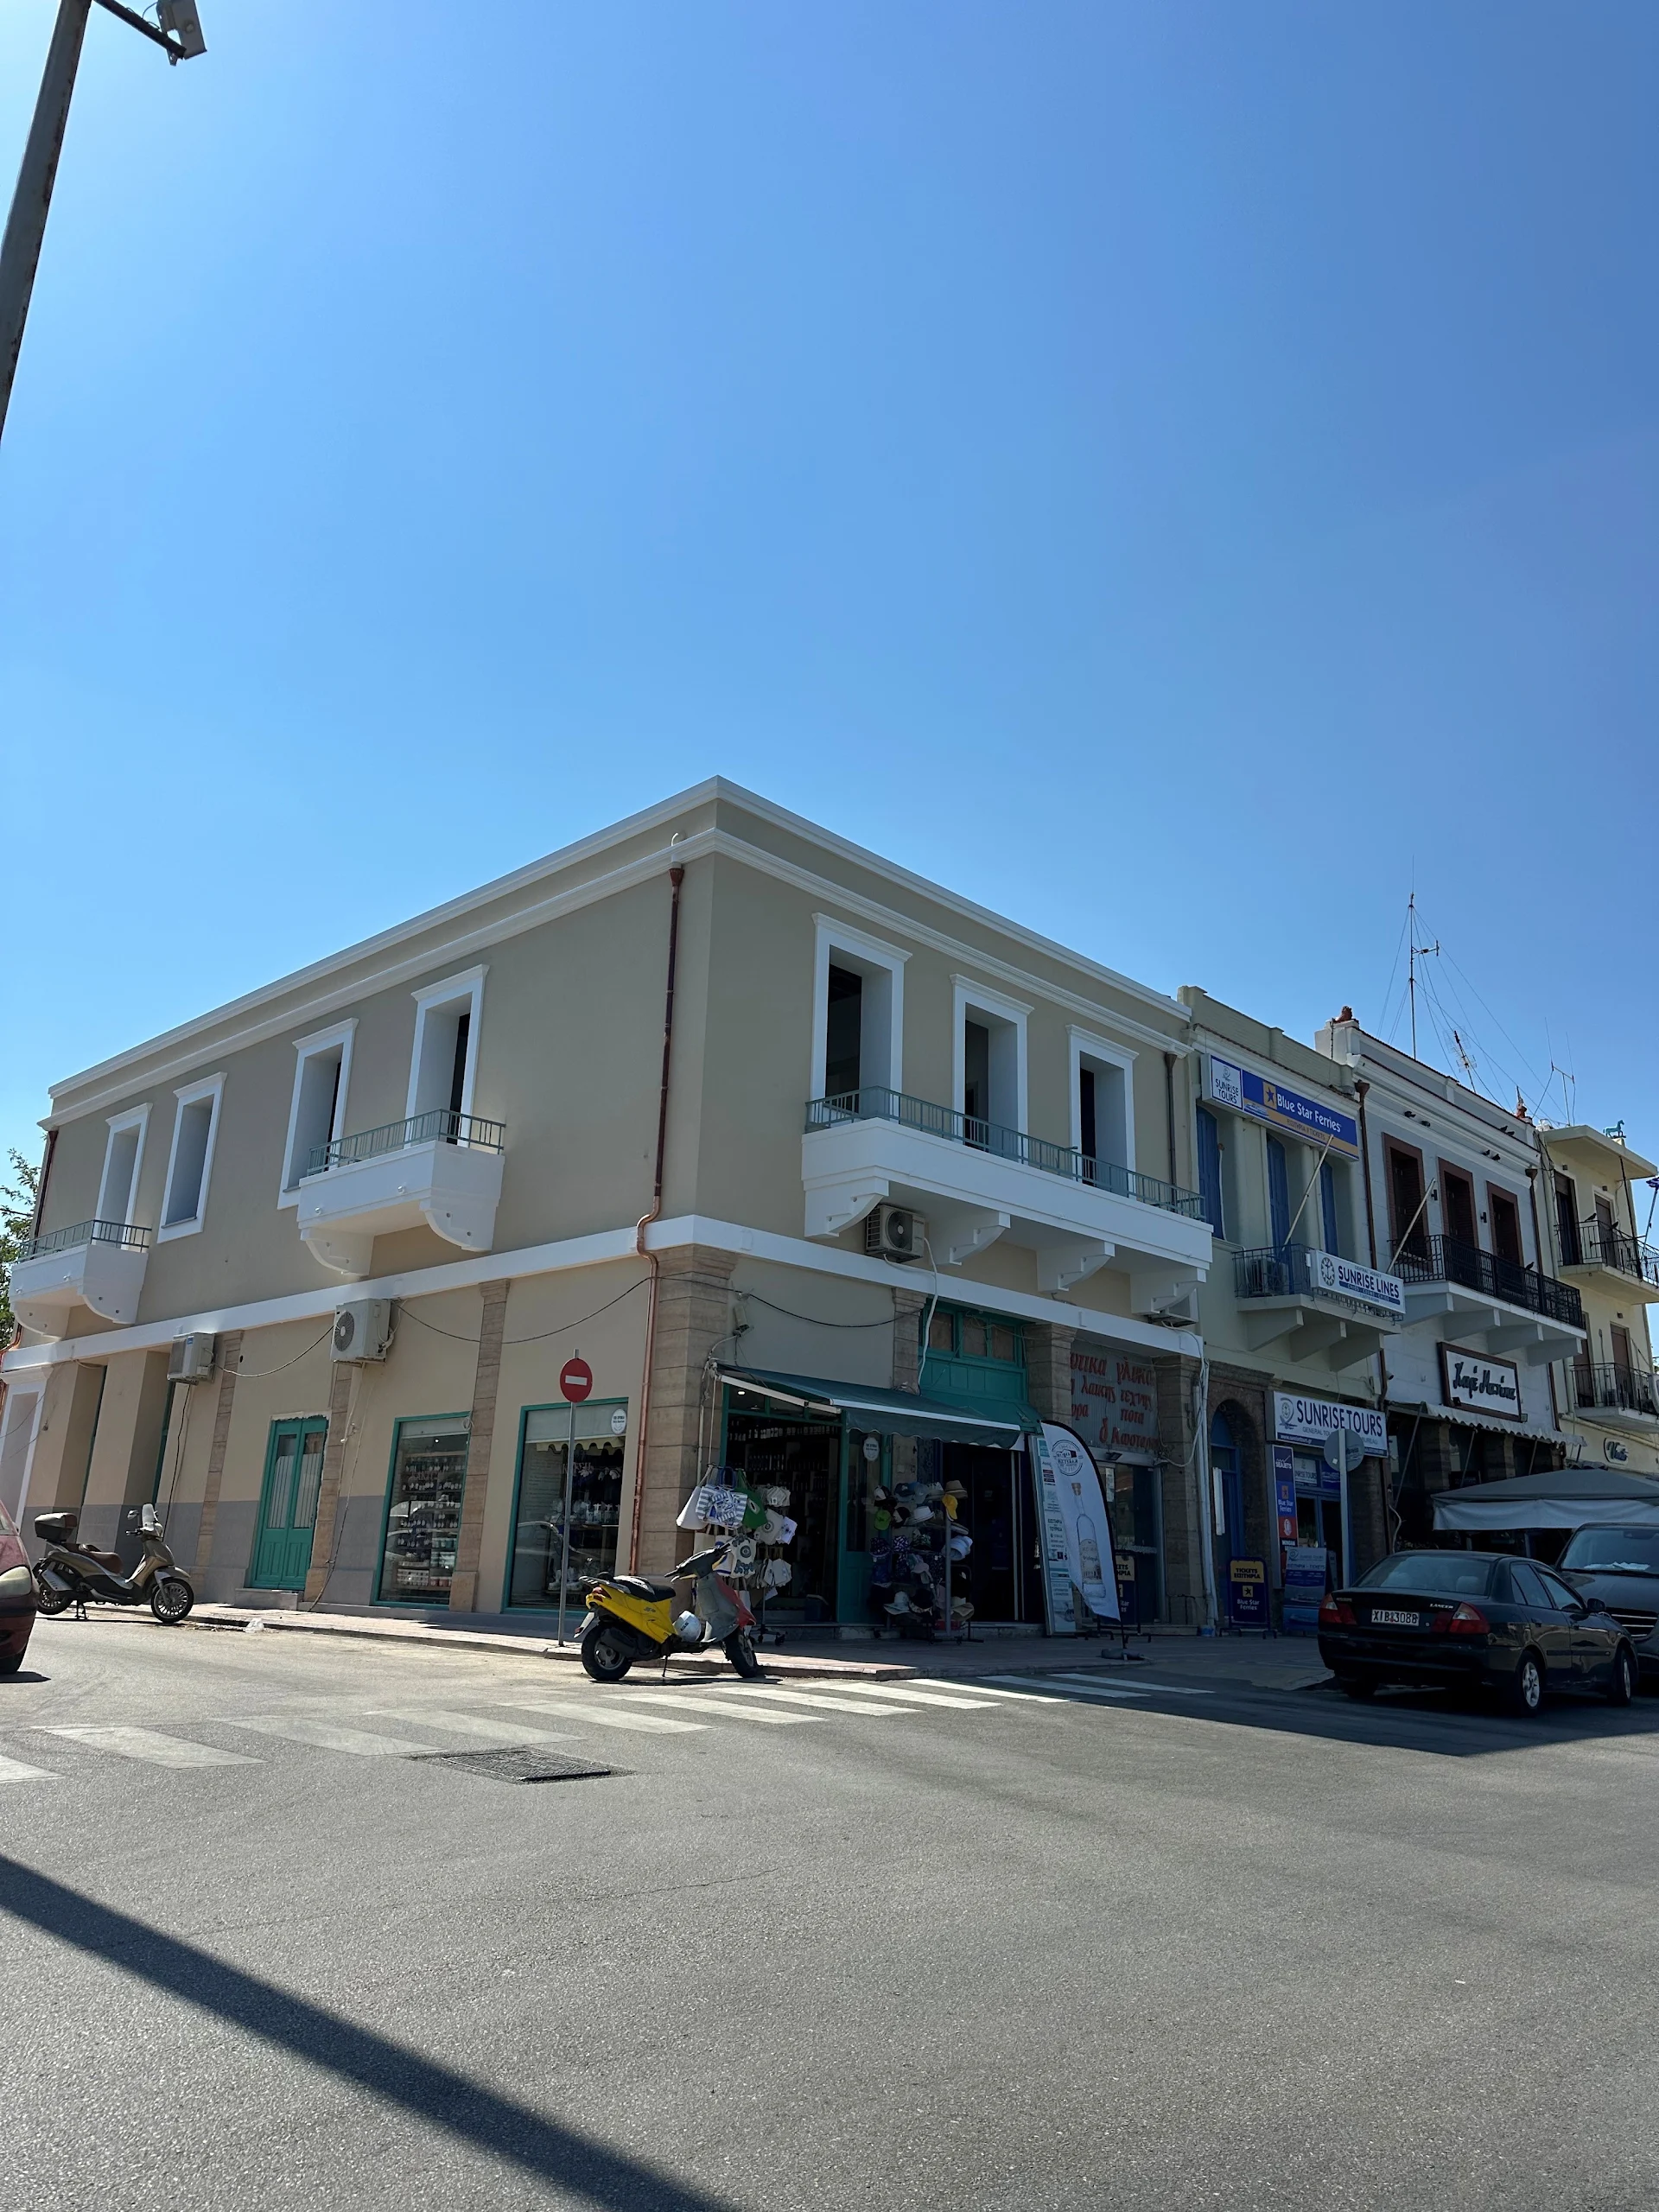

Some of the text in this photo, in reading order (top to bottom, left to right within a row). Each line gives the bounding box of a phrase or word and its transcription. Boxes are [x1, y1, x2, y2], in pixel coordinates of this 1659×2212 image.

[1215, 1078, 1239, 1096] SUNRISE
[1217, 1090, 1237, 1104] TOURS
[1277, 1094, 1341, 1133] Blue Star Ferries
[1338, 1266, 1375, 1290] SUNRISE
[1376, 1279, 1399, 1299] LINES
[1296, 1400, 1382, 1437] SUNRISE TOURS
[1302, 1427, 1323, 1436] GENERAL
[1275, 1461, 1292, 1470] SEAJETS
